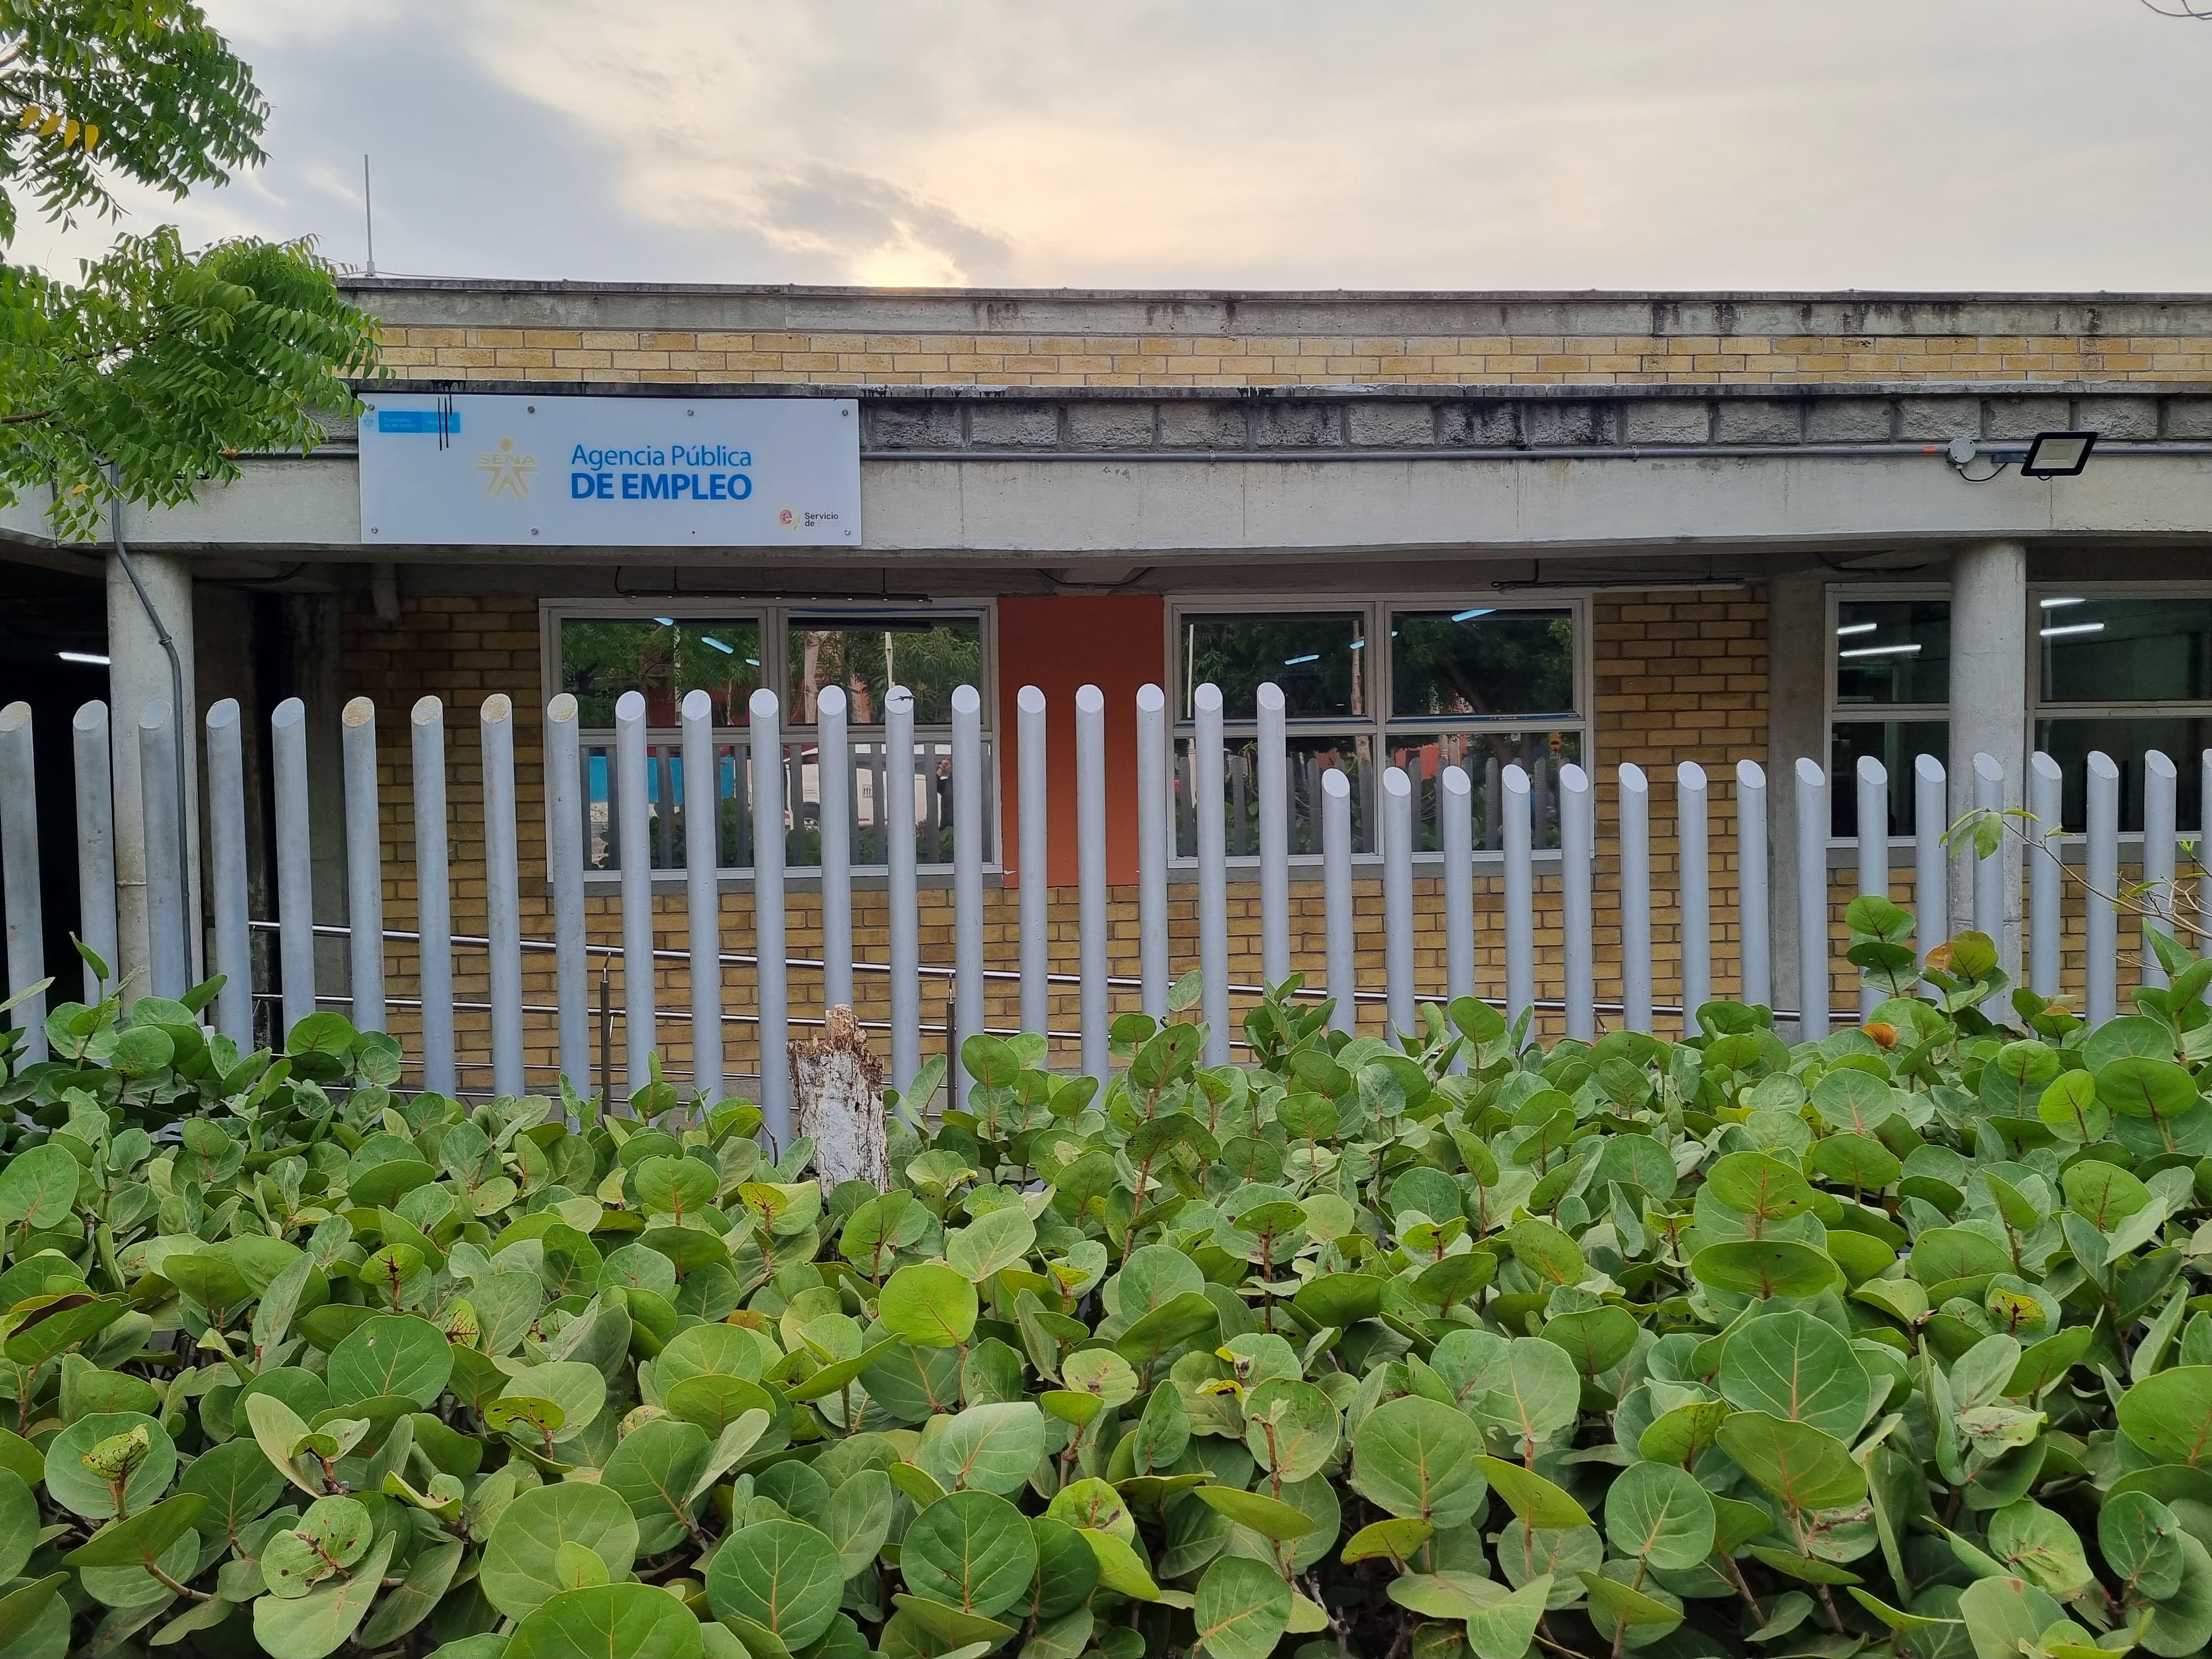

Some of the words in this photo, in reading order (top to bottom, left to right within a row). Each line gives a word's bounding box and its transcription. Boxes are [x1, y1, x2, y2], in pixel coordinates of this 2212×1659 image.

[479, 454, 536, 465] SENA
[571, 444, 664, 471] Agencia
[672, 445, 751, 466] Pública
[571, 473, 614, 499] DE
[622, 474, 752, 500] EMPLEO
